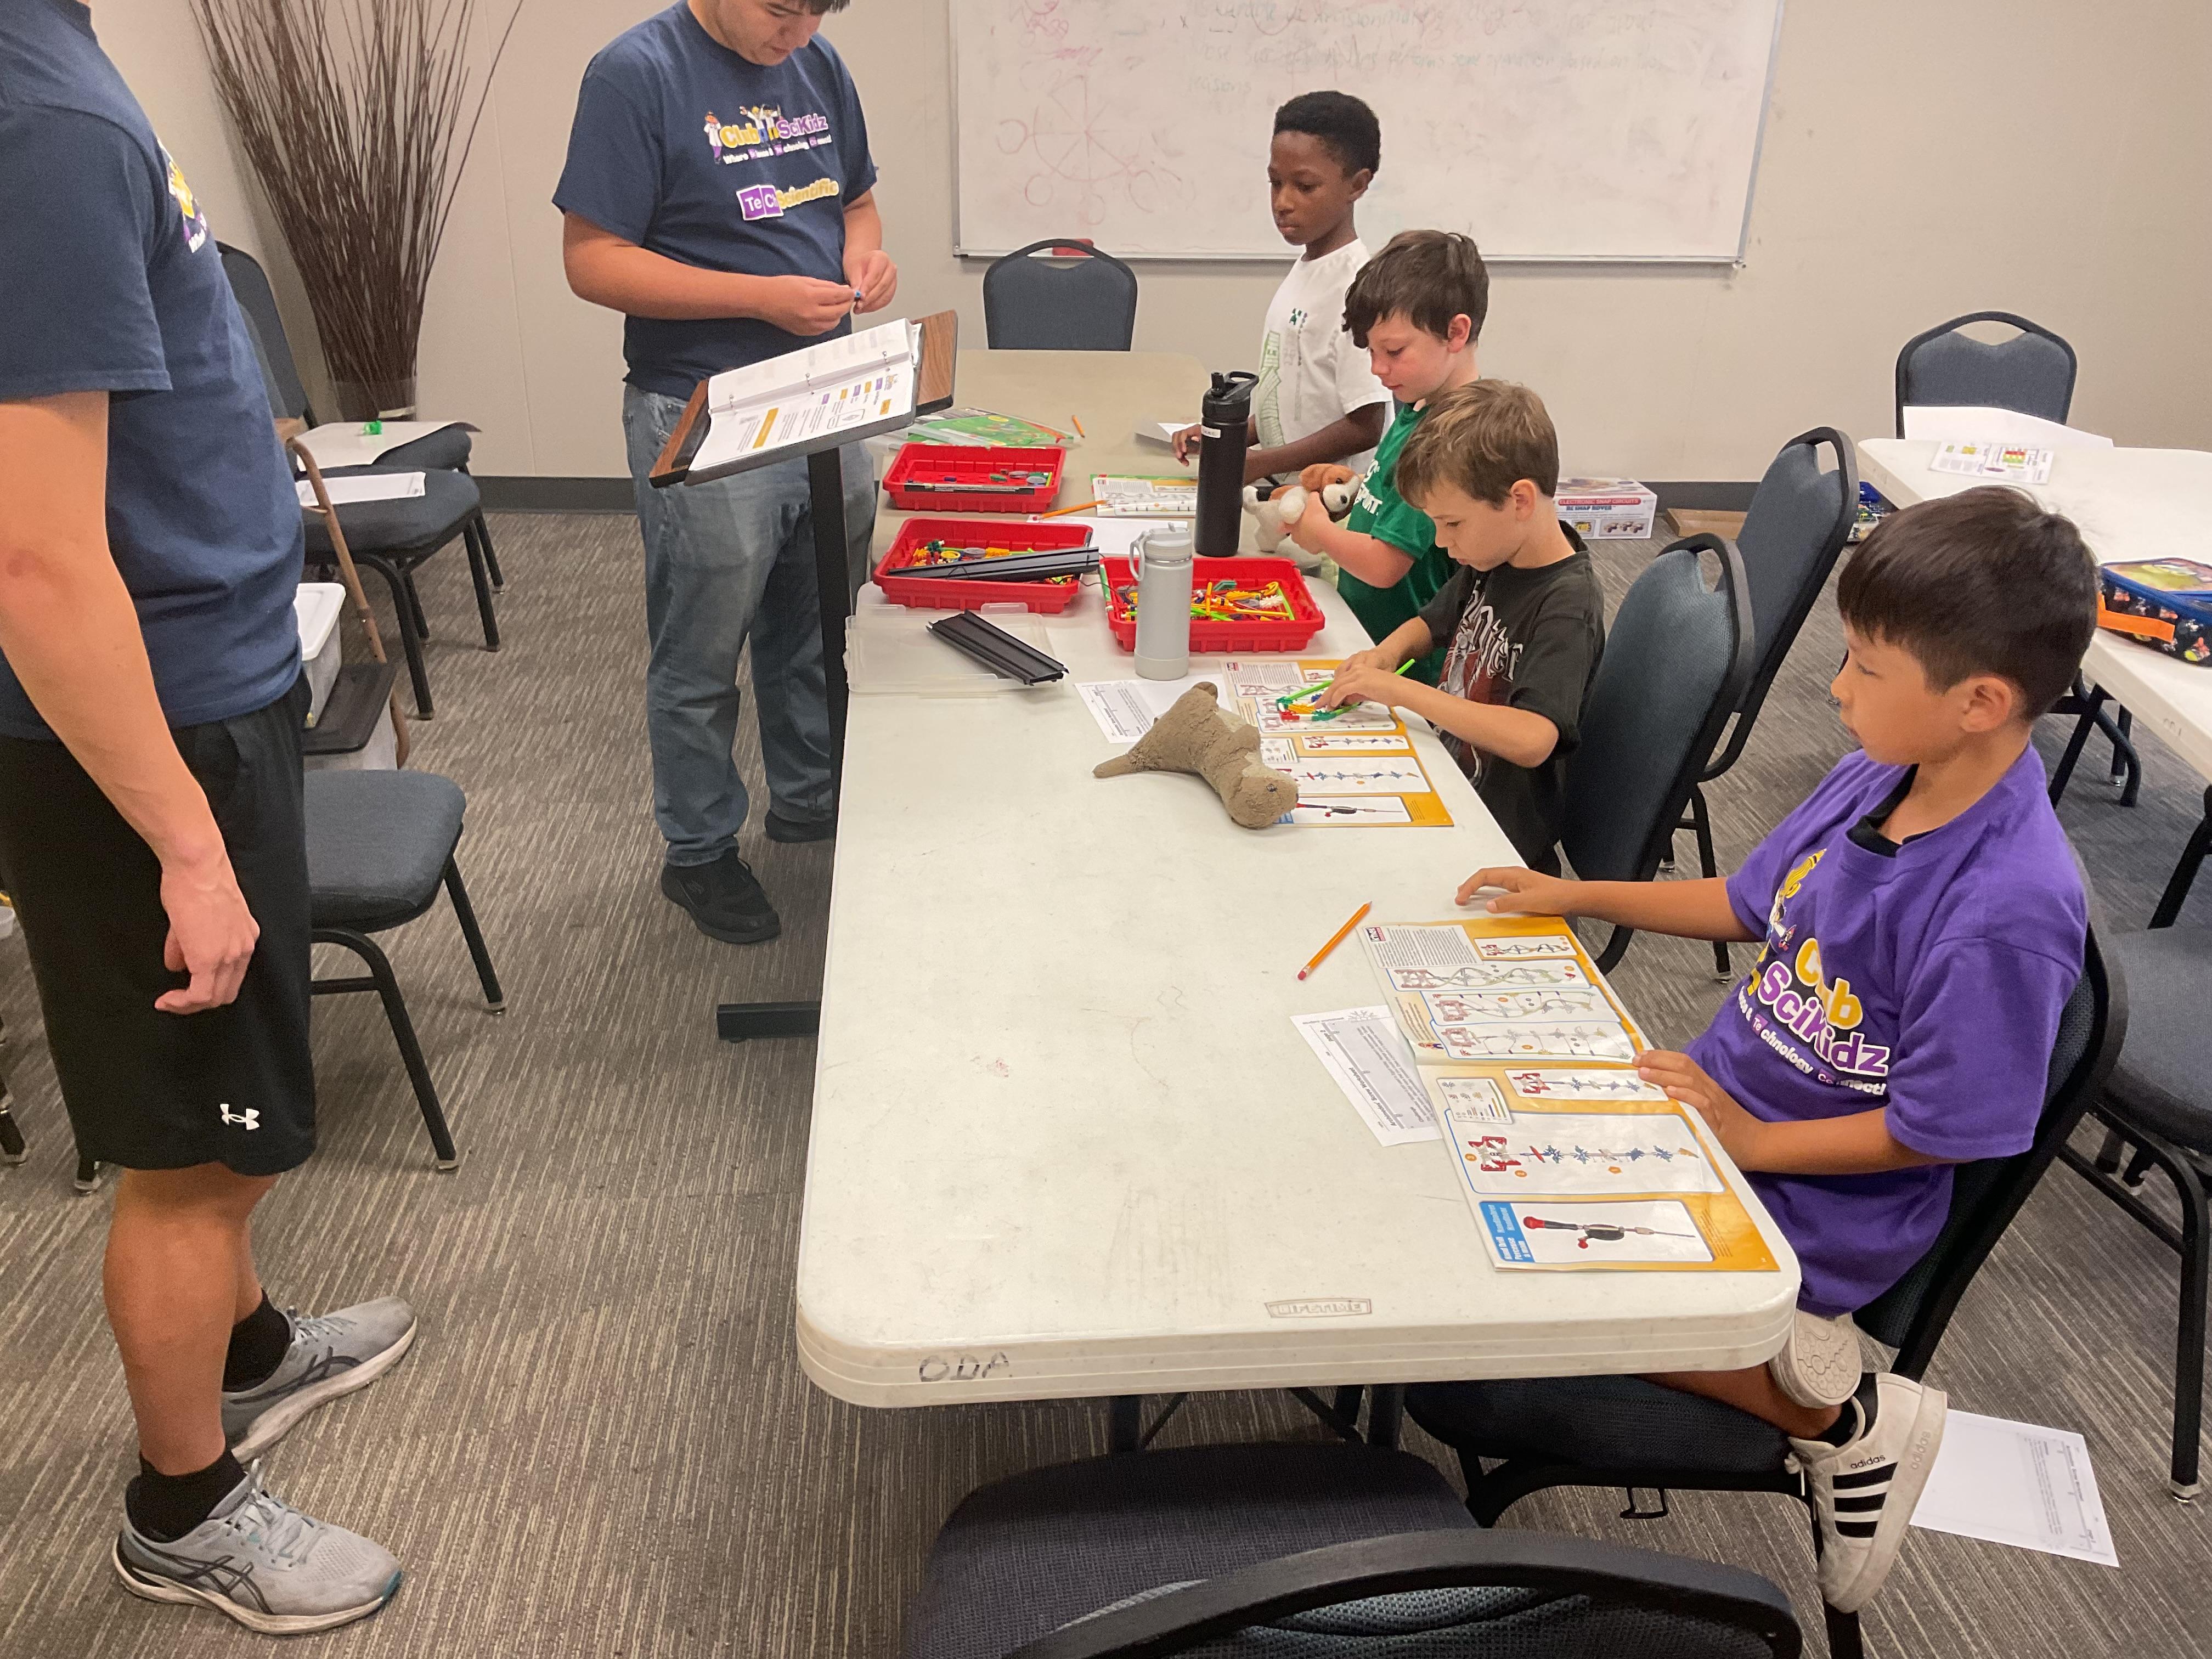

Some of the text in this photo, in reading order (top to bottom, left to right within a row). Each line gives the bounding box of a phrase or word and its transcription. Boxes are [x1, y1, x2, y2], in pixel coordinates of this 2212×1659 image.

[719, 113, 829, 149] Club SciKidz
[1757, 961, 1890, 1077] SciKidz
[1752, 1015, 1814, 1075] Technology
[1277, 1303, 1363, 1314] LIFETIME
[1850, 1455, 1886, 1469] adidas
[1911, 1431, 1932, 1470] adidas
